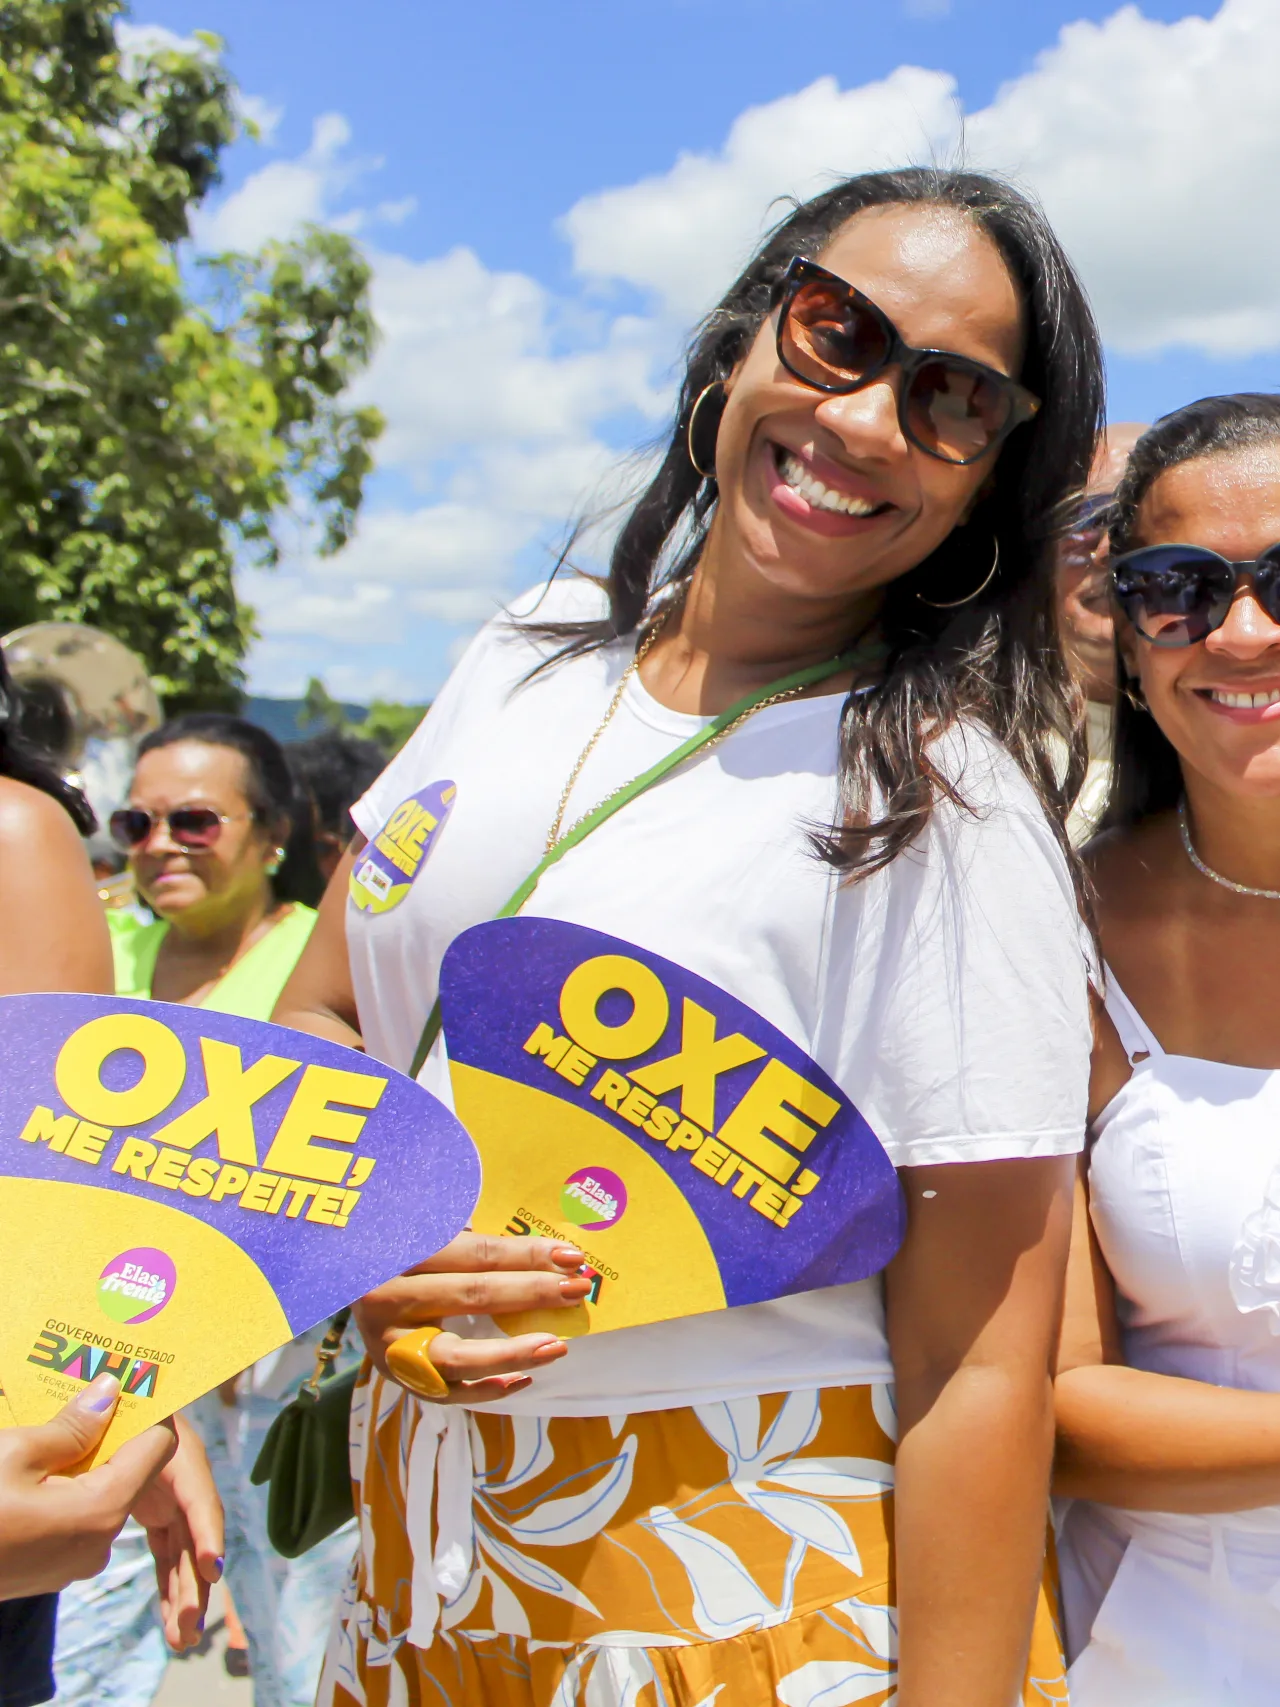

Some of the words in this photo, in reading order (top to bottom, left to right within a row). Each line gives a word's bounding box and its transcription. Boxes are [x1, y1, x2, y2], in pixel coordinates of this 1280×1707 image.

[54, 1013, 389, 1188] OXE,
[560, 954, 842, 1196] OXE,
[19, 1105, 109, 1166] ME
[111, 1135, 361, 1229] RESPEITE!
[522, 1022, 598, 1087] ME
[590, 1070, 804, 1229] RESPEITE!
[101, 1272, 166, 1305] frente
[119, 1262, 160, 1288] Elas
[26, 1329, 160, 1399] BAHIA
[45, 1318, 113, 1348] GOVERNO
[114, 1340, 134, 1355] DO
[134, 1346, 176, 1365] ESTADO
